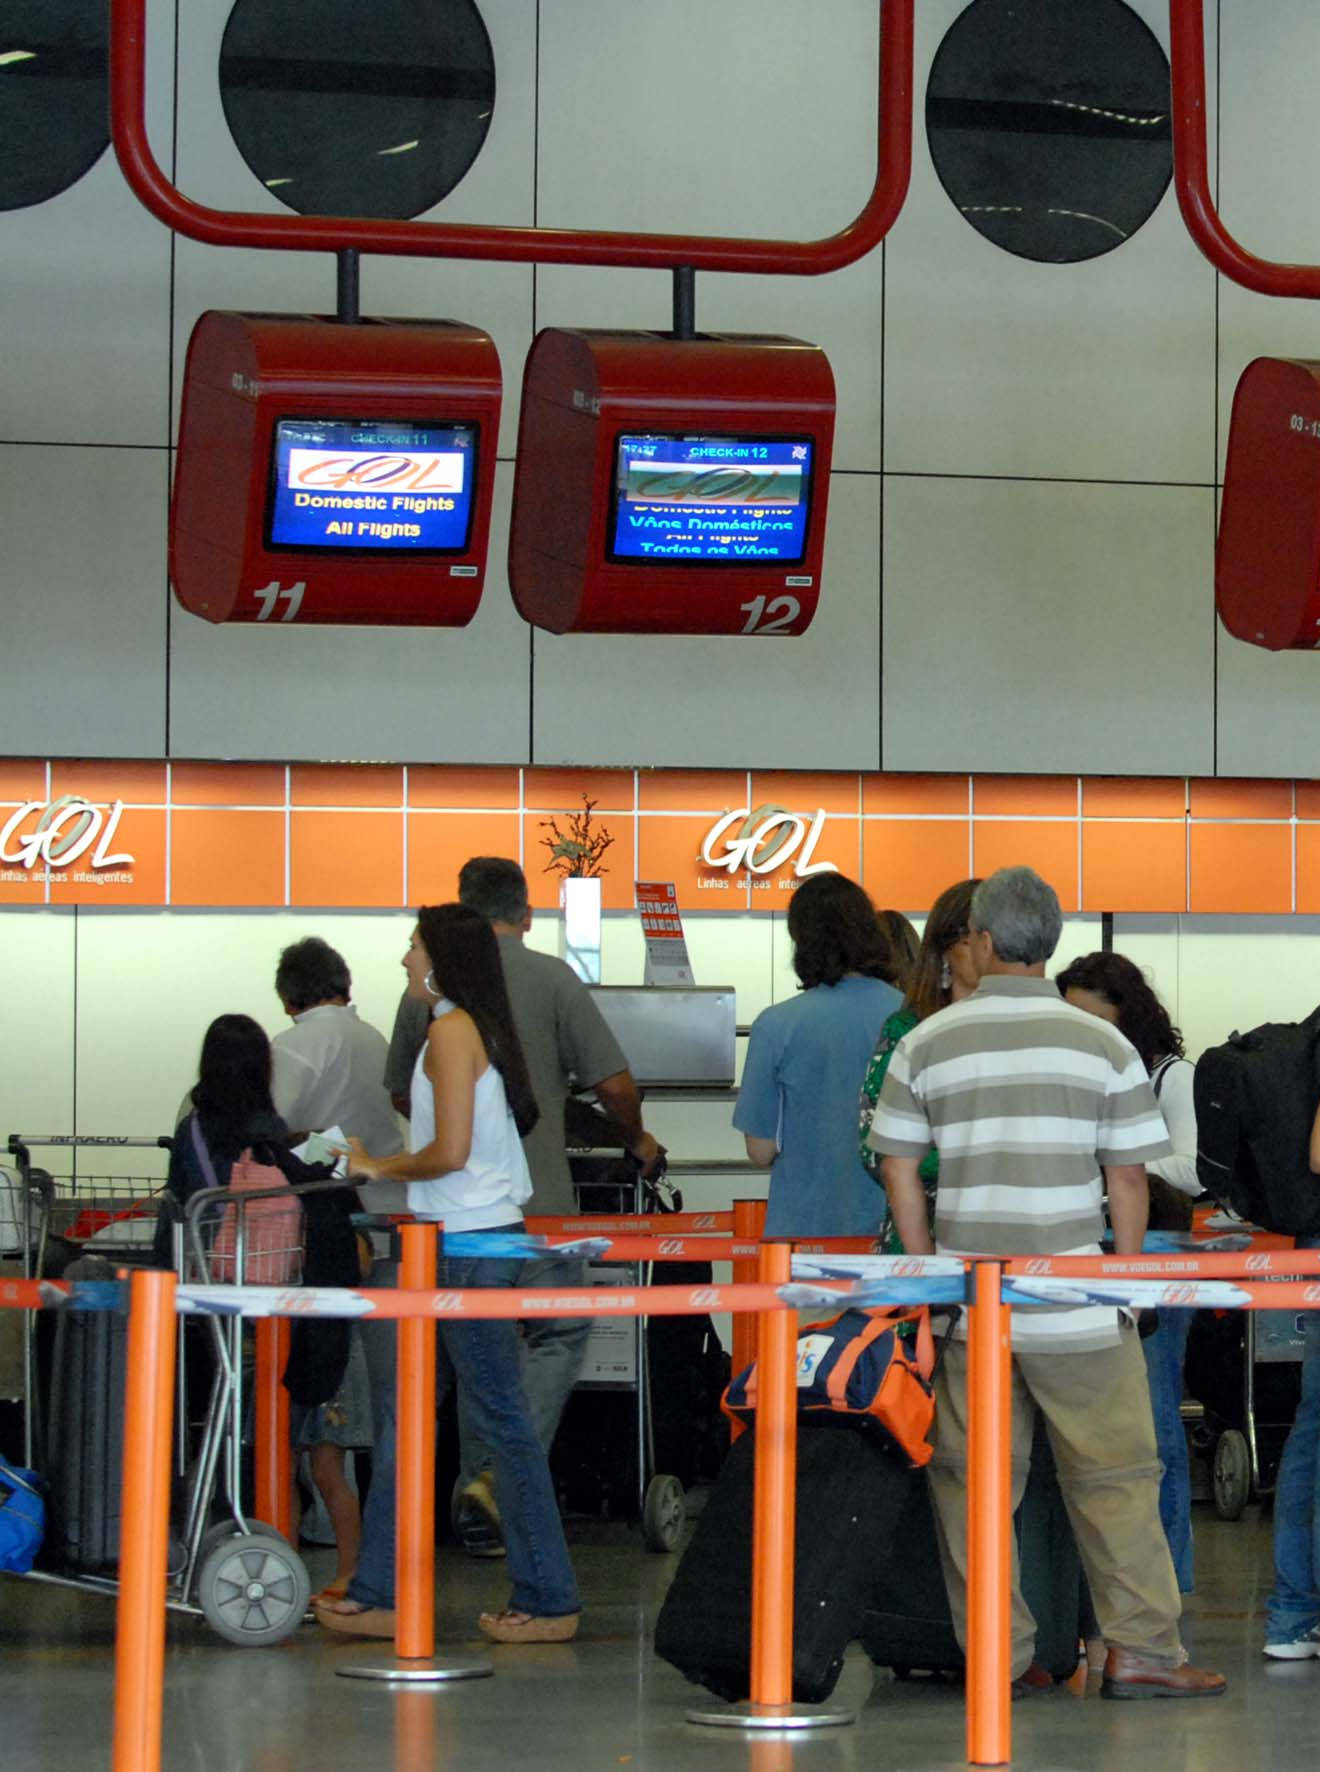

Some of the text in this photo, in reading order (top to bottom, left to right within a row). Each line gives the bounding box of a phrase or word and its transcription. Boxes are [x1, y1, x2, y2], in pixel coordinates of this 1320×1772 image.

[690, 447, 768, 459] CHECK-IN 12
[298, 455, 453, 490] GOL
[637, 467, 797, 502] GOL
[295, 493, 455, 513] Domestic Flights
[326, 521, 421, 539] All Flights
[254, 580, 306, 622] 11
[740, 594, 801, 634] 12
[0, 794, 136, 869] GOL
[702, 803, 839, 878] GOL
[0, 869, 28, 882] inhas
[697, 876, 729, 889] Linhas
